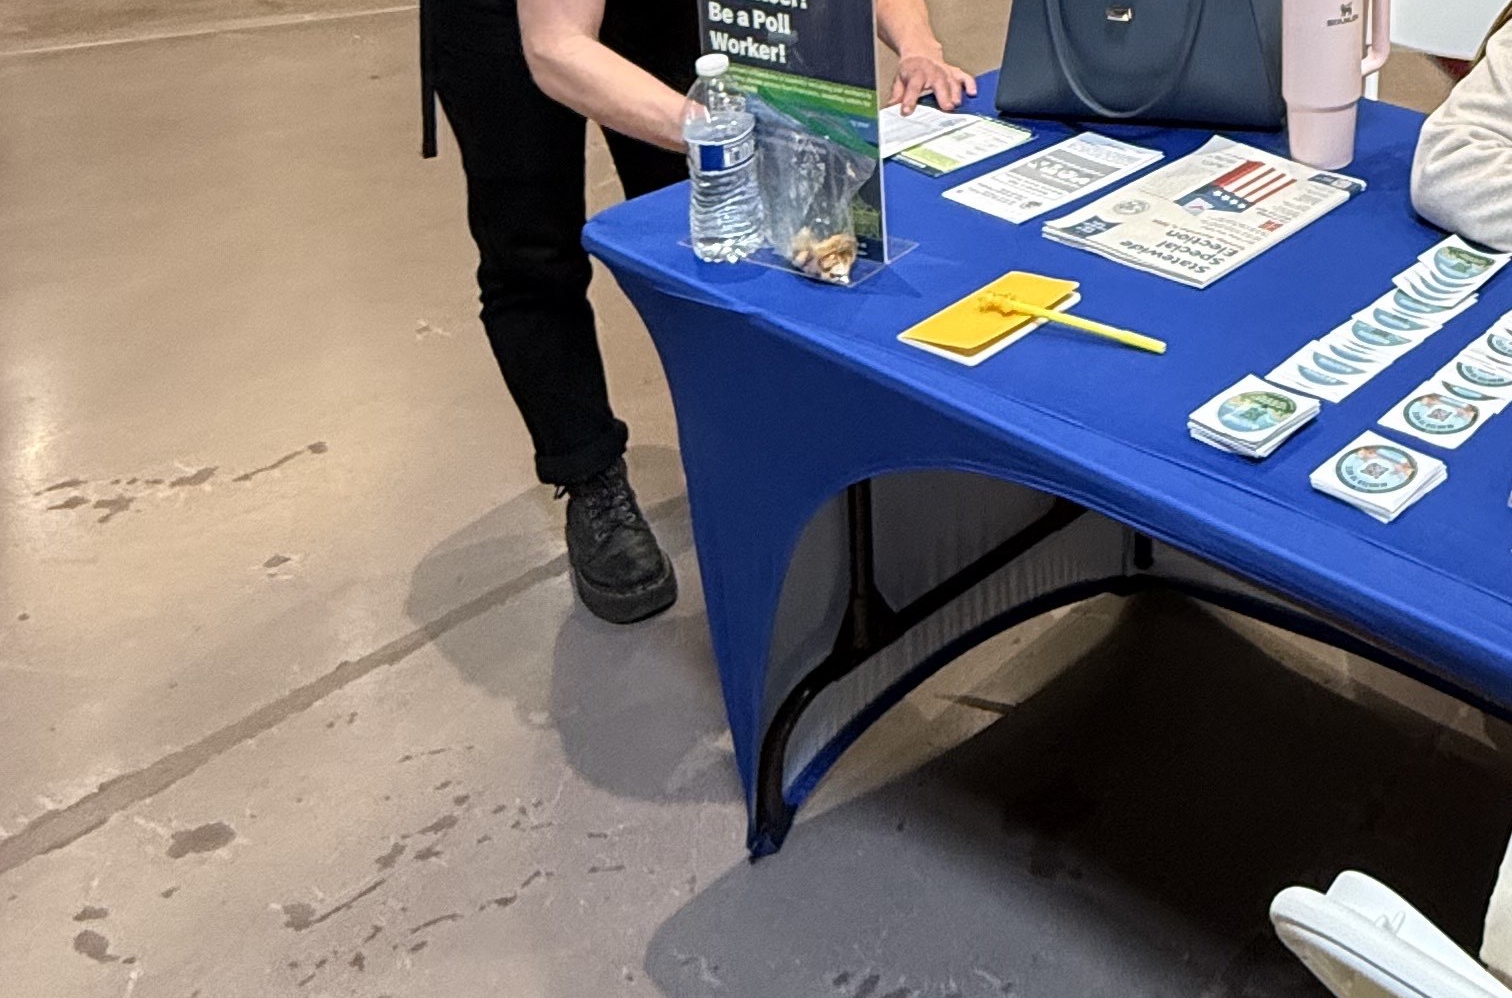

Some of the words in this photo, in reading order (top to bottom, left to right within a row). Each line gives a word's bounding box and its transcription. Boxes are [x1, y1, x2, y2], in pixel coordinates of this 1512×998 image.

[708, 1, 734, 25] Be
[736, 11, 750, 28] a
[752, 9, 791, 35] Poll
[709, 30, 787, 64] Worker!
[1119, 239, 1211, 274] Statewide
[1156, 240, 1225, 266] Special
[1165, 229, 1239, 258] Election
